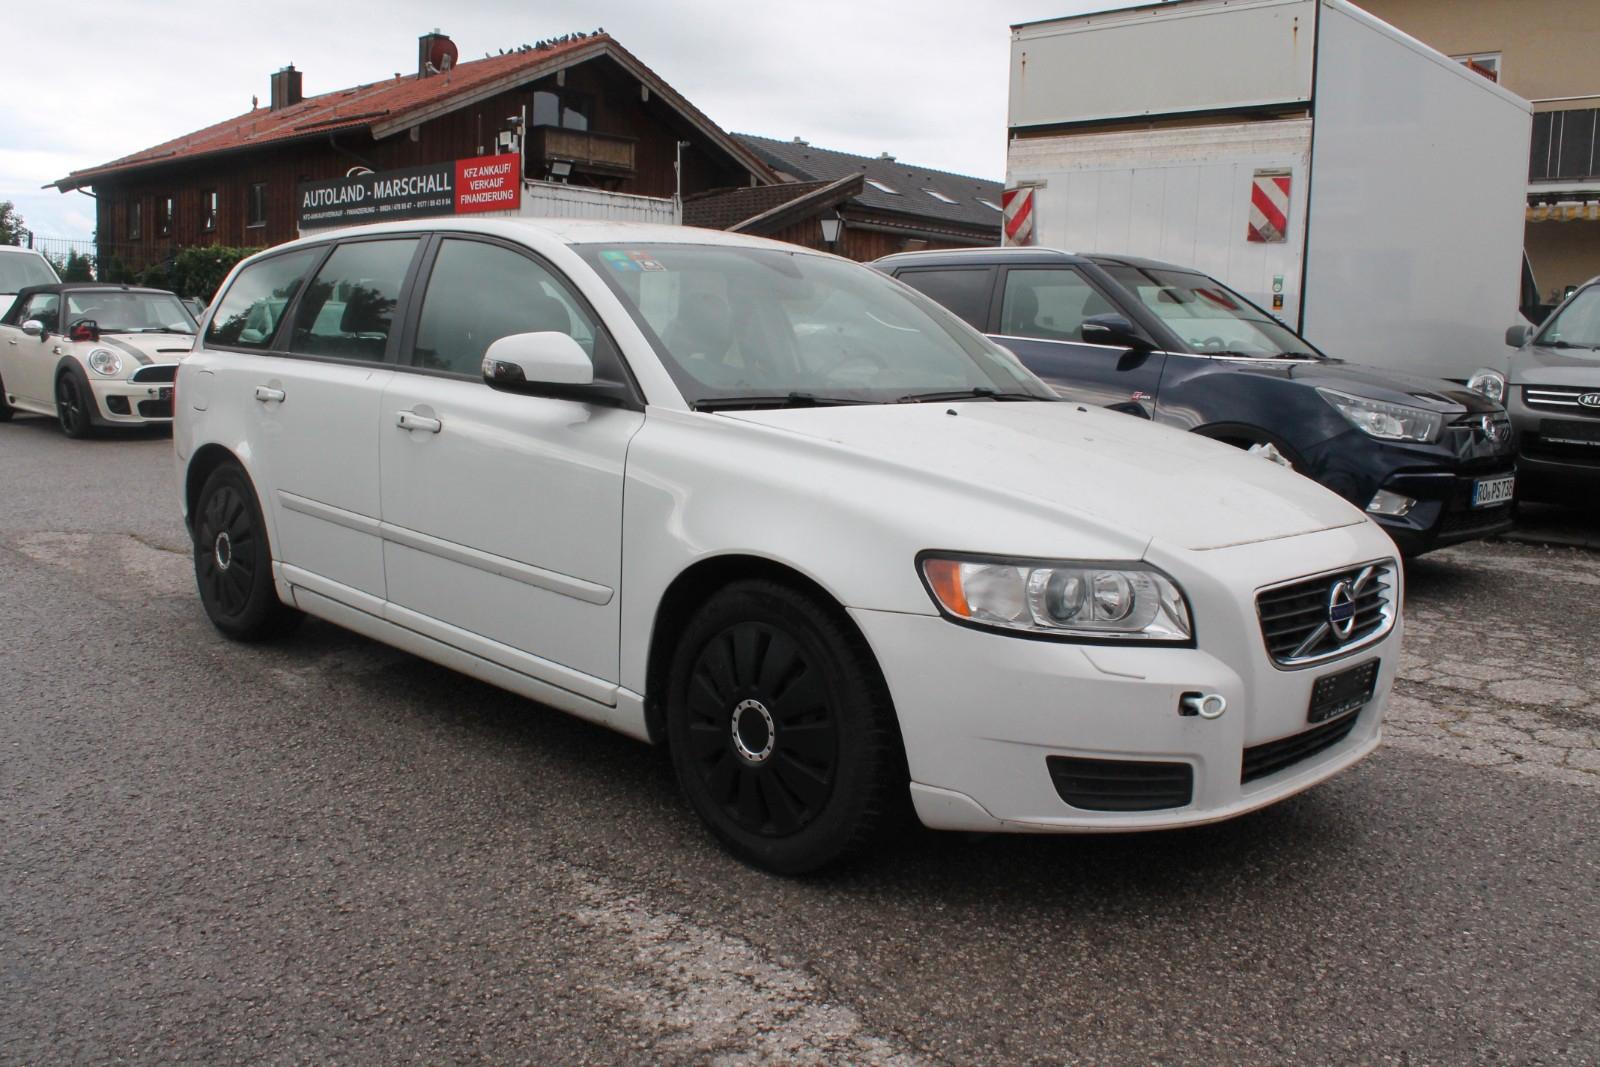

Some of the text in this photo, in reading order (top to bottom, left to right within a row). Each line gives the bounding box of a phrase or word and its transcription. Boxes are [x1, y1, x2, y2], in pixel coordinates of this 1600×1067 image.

[464, 162, 511, 179] KFZ ANKAUF/
[303, 184, 365, 208] AUTOLAND
[374, 172, 452, 199] MARSCHALL
[470, 177, 504, 190] VERKAUF
[461, 189, 514, 205] FINANZIERUNG
[1584, 395, 1600, 404] KI
